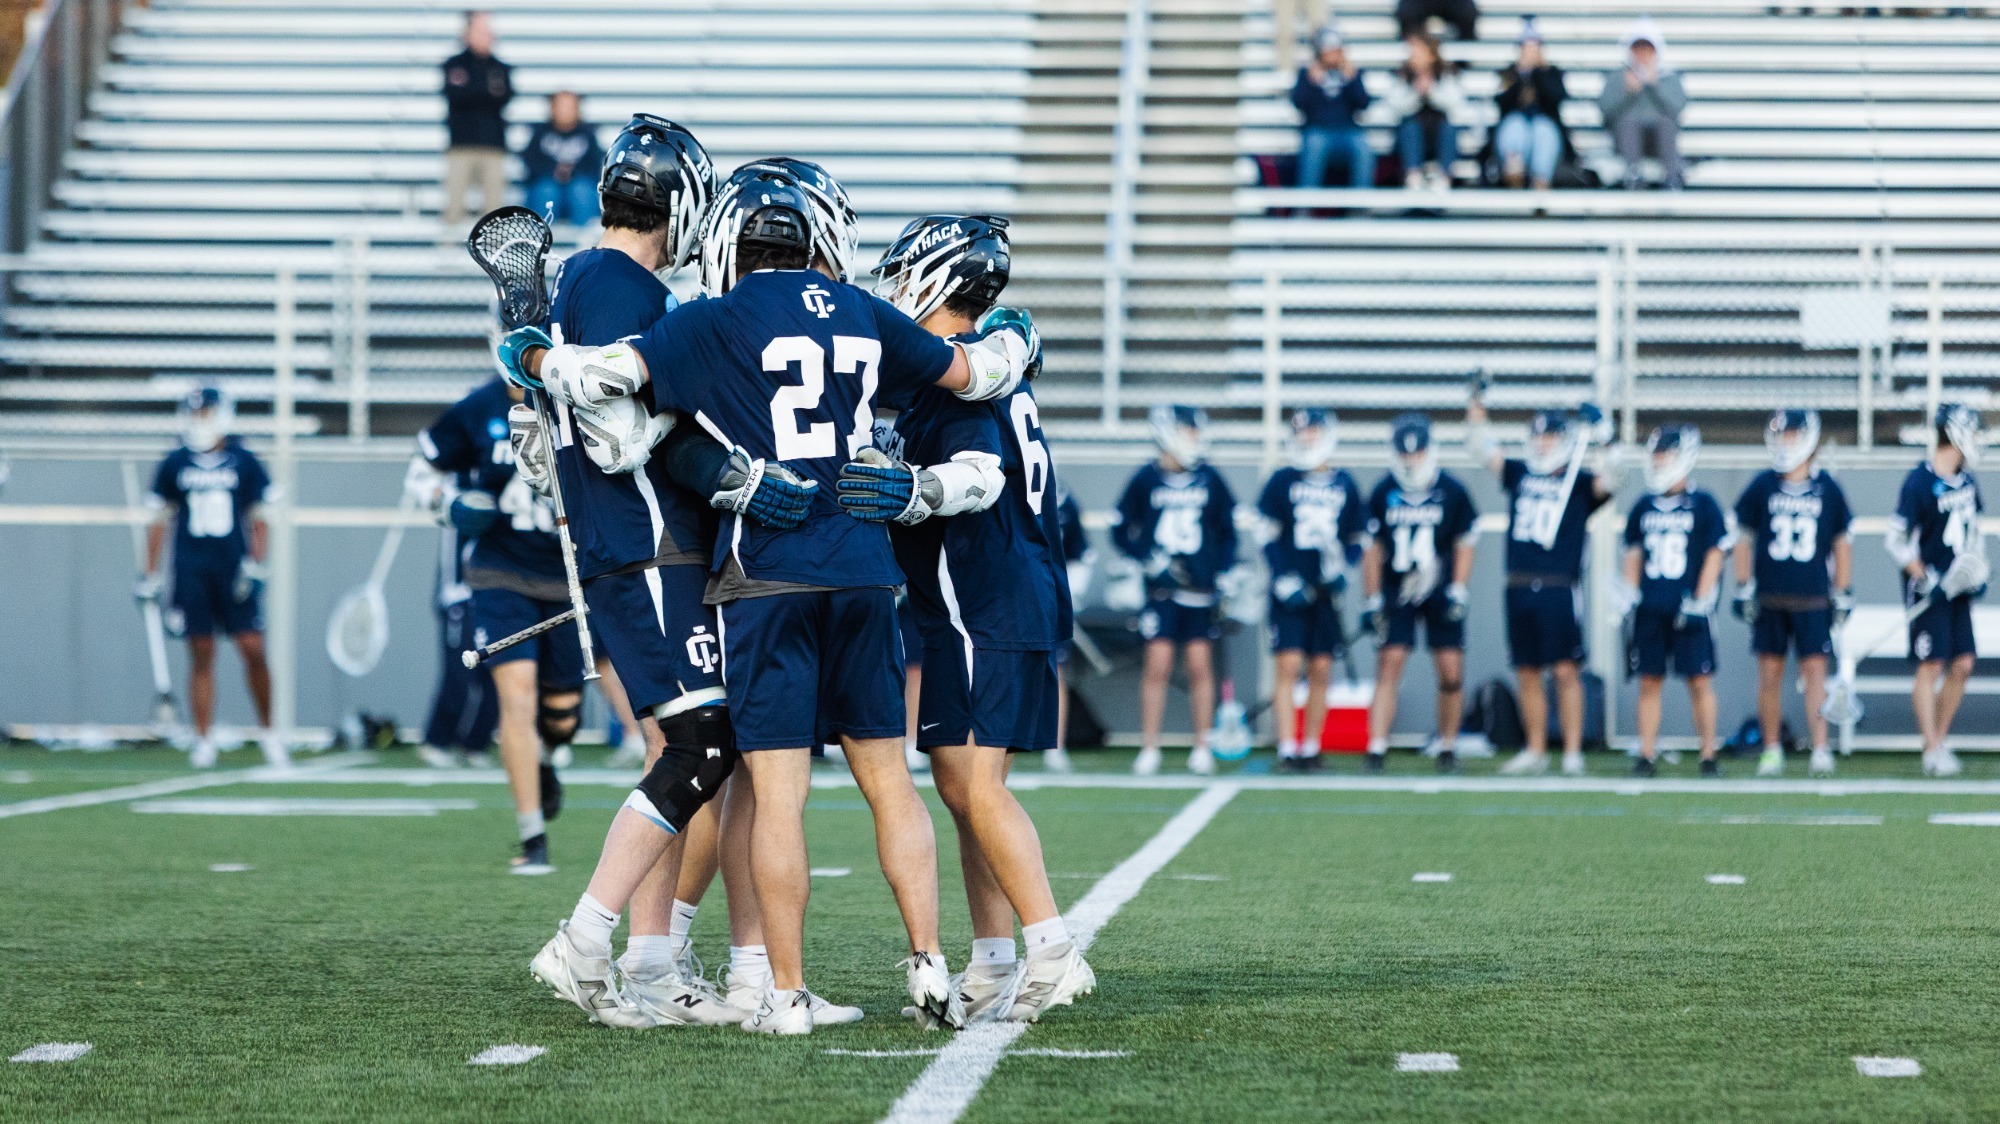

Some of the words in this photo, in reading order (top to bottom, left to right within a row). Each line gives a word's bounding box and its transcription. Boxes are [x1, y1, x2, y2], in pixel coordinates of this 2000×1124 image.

[909, 222, 962, 260] THACA
[762, 335, 882, 461] 27
[1010, 391, 1048, 516] 6
[1392, 524, 1437, 572] 14
[1767, 515, 1818, 562] 33
